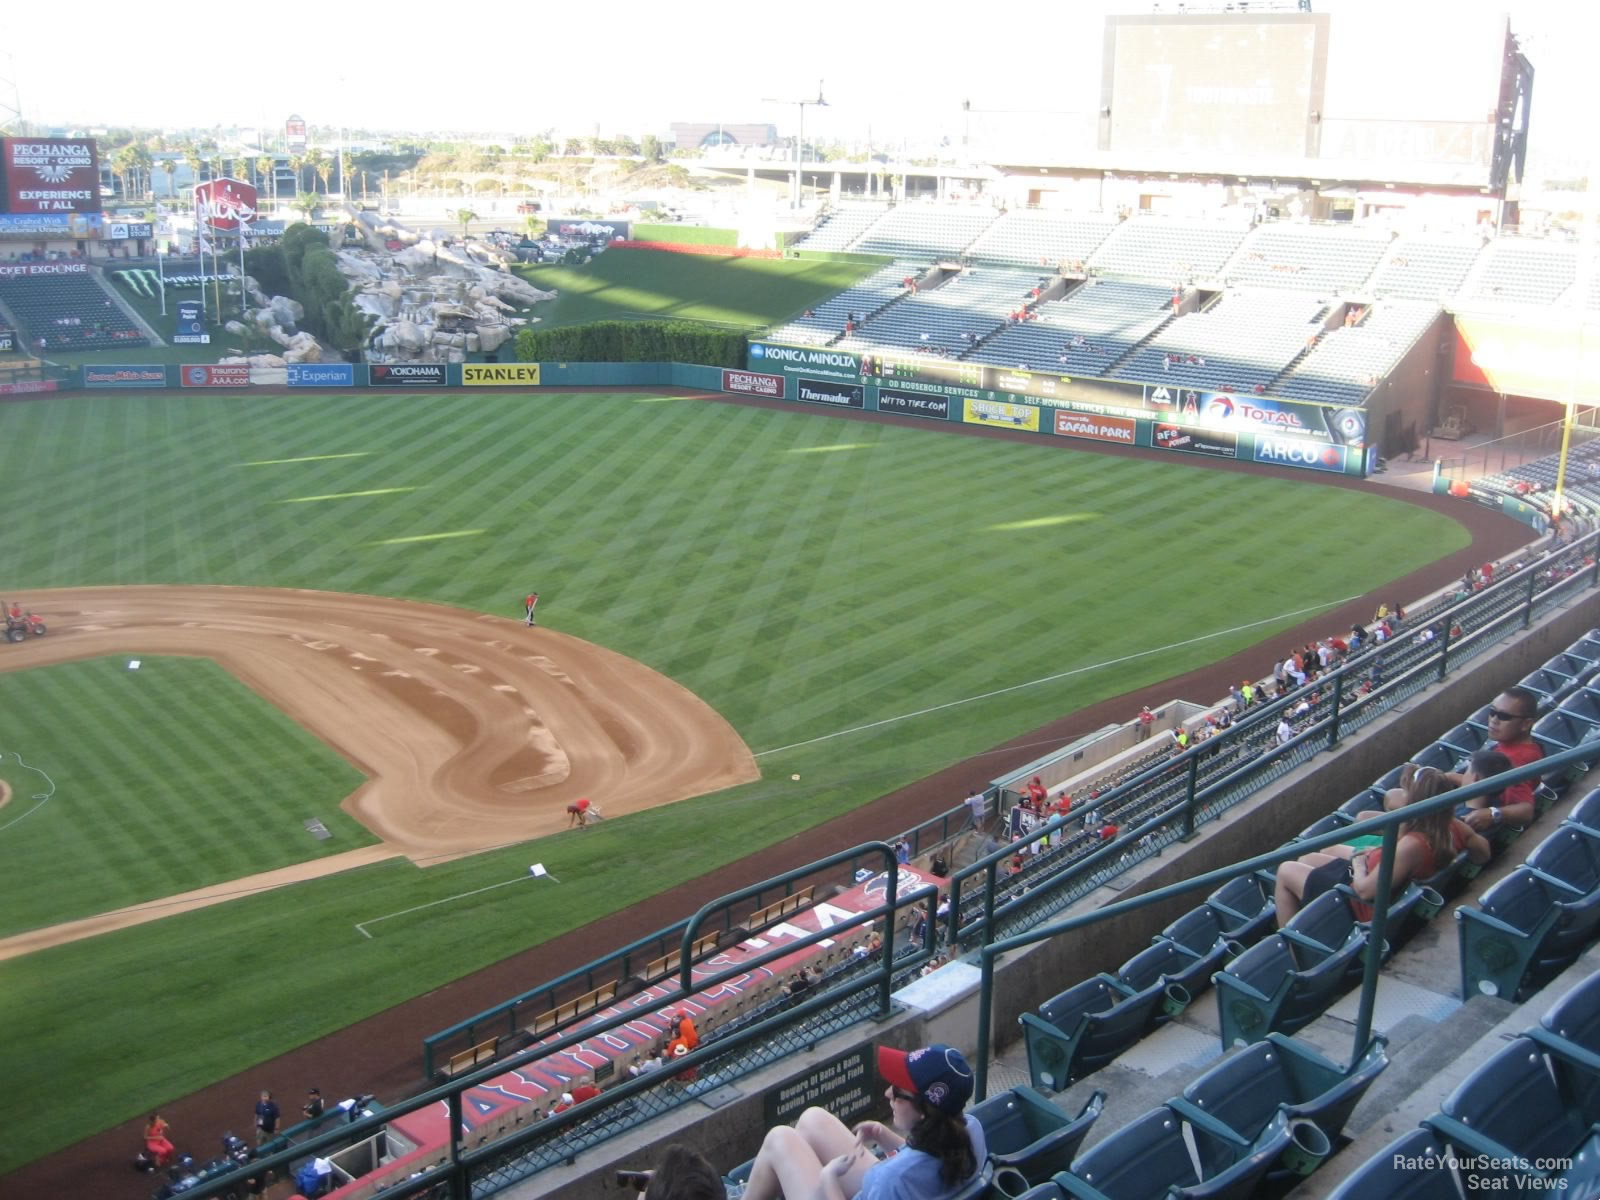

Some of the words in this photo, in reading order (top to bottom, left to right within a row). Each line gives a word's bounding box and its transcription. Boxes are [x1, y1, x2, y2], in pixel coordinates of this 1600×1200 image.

[13, 144, 91, 156] PECHANGA
[13, 157, 49, 165] RESORT
[57, 157, 92, 165] CASINO
[20, 190, 92, 200] EXPERIENCE
[39, 201, 50, 210] IT
[53, 201, 75, 210] ALL
[267, 228, 284, 236] box
[764, 347, 807, 363] KONICA
[808, 352, 857, 368] MINOLTA
[212, 367, 248, 375] Insuranc
[302, 370, 346, 382] Experian
[390, 367, 440, 376] YOKOHAMA
[465, 368, 537, 380] STANLEY
[729, 373, 777, 388] PECHANGA
[901, 381, 943, 393] HOUSEHOLD
[944, 386, 980, 397] SERVICES
[800, 388, 850, 404] Thermador
[881, 395, 905, 406] NITTO
[907, 400, 946, 413] TIRE.COM
[1239, 405, 1302, 426] TOTAL
[1058, 421, 1098, 435] SAFARI
[1100, 426, 1131, 440] PARK
[1157, 429, 1177, 440] aFe
[1259, 441, 1319, 464] ARCO
